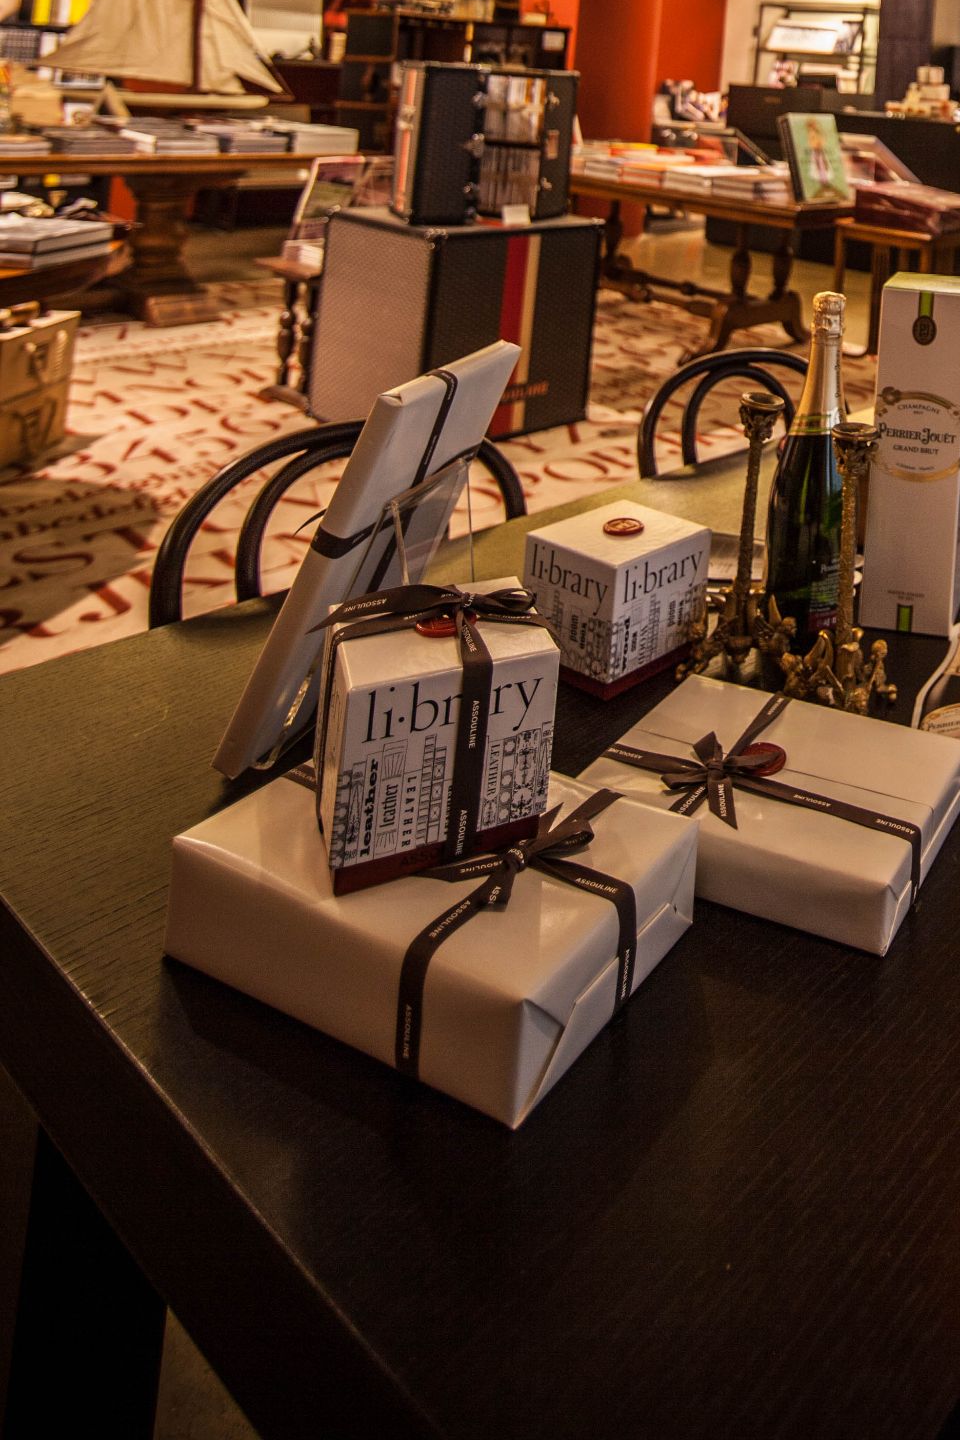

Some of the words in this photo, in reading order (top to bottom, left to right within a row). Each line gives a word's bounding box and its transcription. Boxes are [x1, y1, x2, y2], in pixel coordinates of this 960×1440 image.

[468, 700, 481, 750] ASSOULINE
[487, 743, 500, 797] LEATHER
[360, 758, 379, 858] leather
[379, 783, 399, 828] leather
[401, 775, 418, 848] LEATHER
[793, 794, 832, 808] ASSOULINE
[454, 809, 468, 856] ASSOULINE
[876, 817, 916, 836] ASSOULINE
[575, 877, 619, 895] ASSOULINE
[428, 900, 471, 939] ASSOULINE
[402, 1004, 412, 1059] ASSOULINE
